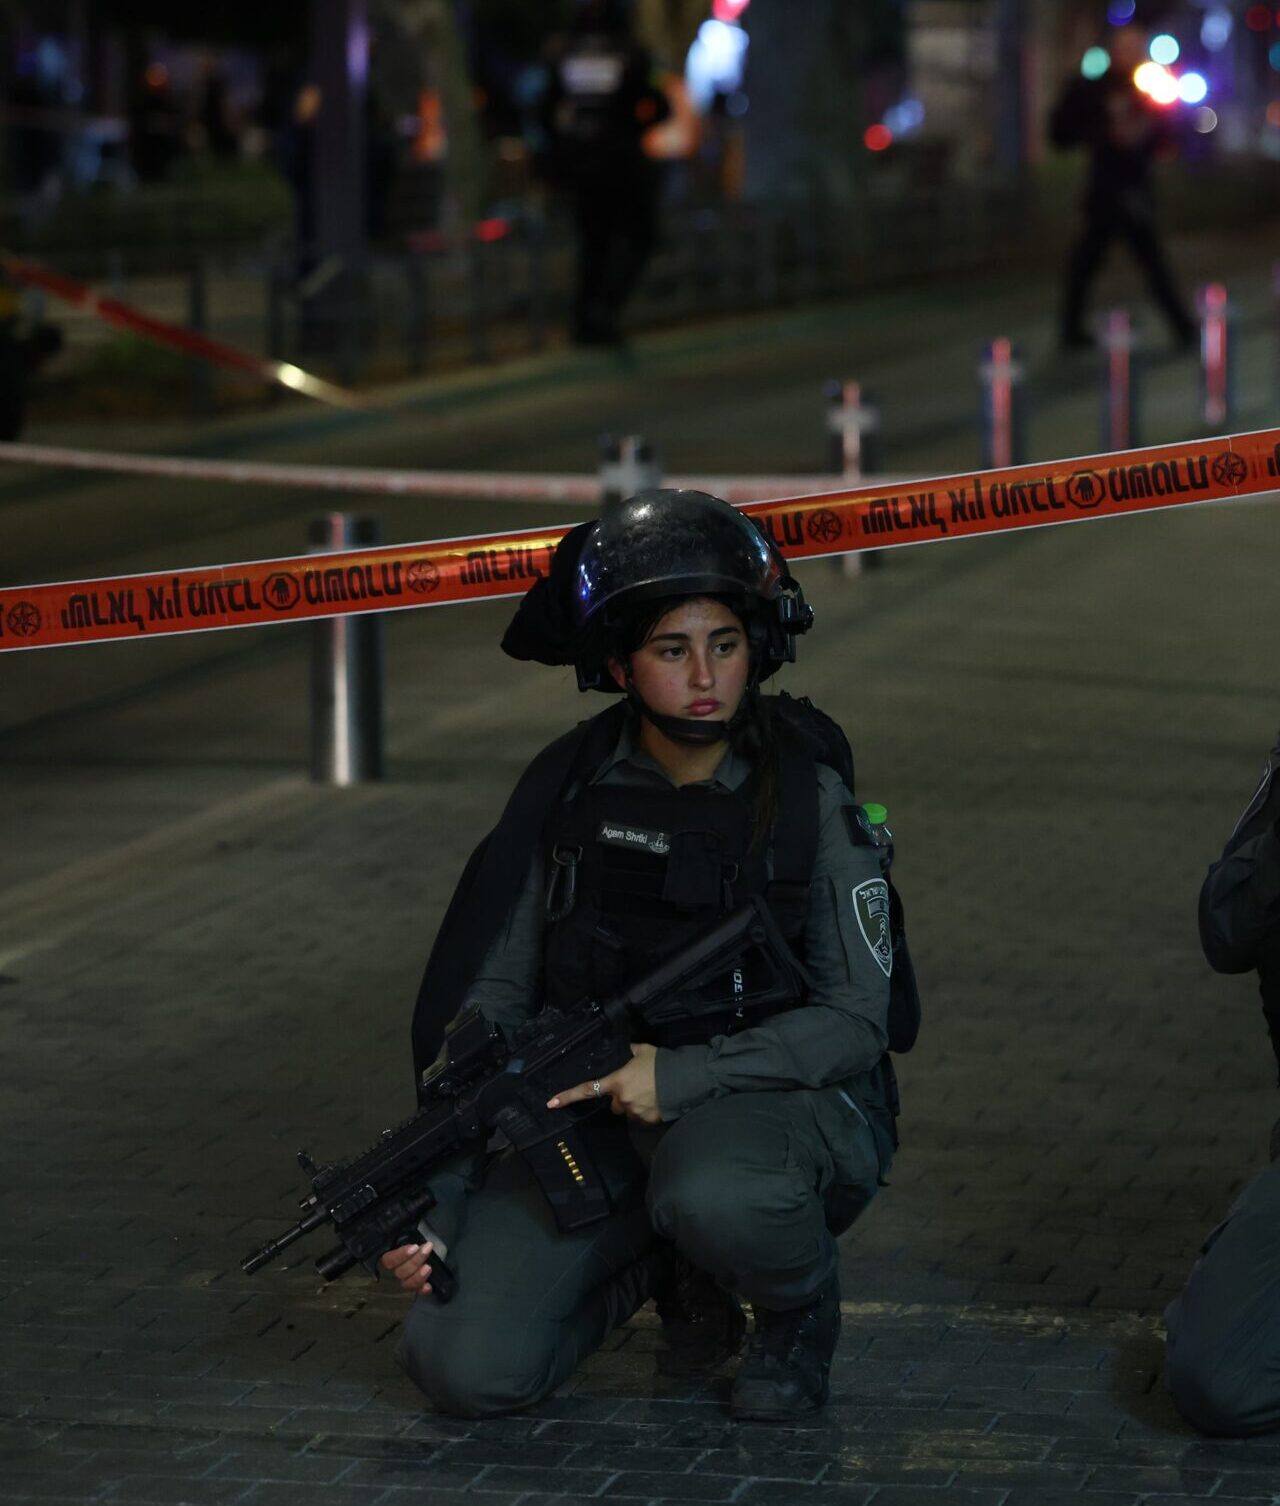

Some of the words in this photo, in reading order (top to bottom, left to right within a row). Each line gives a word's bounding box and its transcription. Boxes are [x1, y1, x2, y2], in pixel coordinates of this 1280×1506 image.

[62, 593, 144, 630] ישראל
[147, 578, 182, 621] אין
[187, 580, 261, 617] מעבר
[303, 561, 403, 605] משטרת
[459, 547, 543, 585] ישראל
[862, 493, 948, 534] ישראל
[949, 480, 986, 523] אין
[991, 477, 1065, 518] מעבר
[1109, 456, 1208, 502] משטרת
